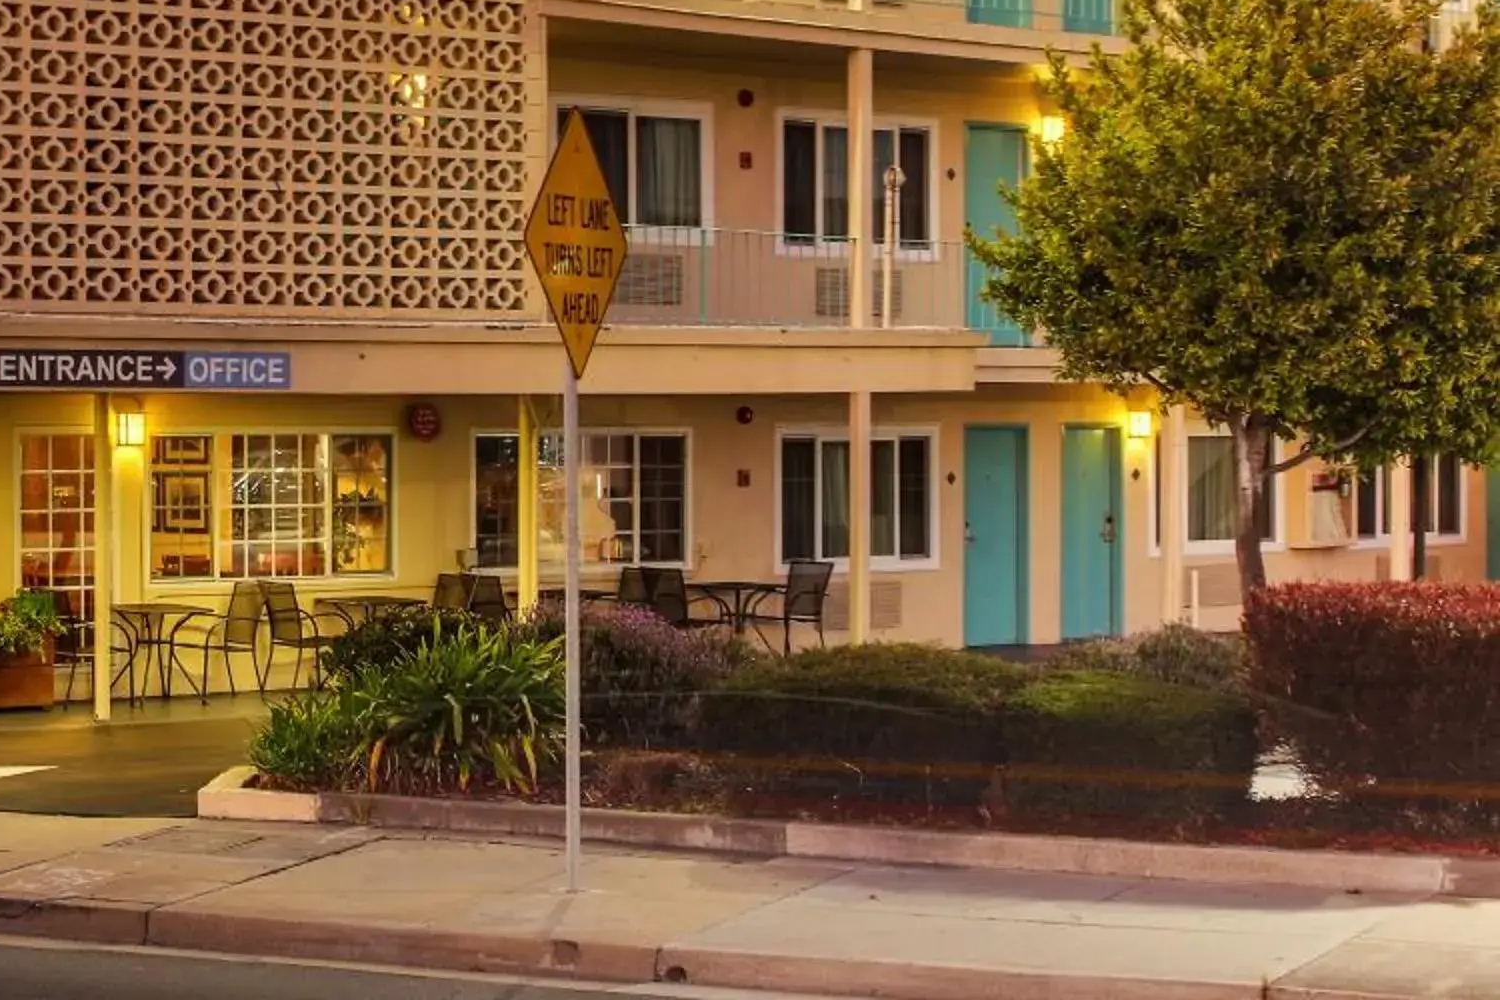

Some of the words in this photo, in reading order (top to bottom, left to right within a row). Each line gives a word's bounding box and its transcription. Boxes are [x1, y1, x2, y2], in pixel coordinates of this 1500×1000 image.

[547, 194, 576, 227] LEFT
[581, 198, 610, 231] LANE
[544, 242, 582, 277] TURNS
[587, 246, 613, 278] LEFT
[562, 292, 599, 325] AHEAD
[0, 355, 153, 381] ENTRANCE
[188, 357, 285, 383] OFFICE
